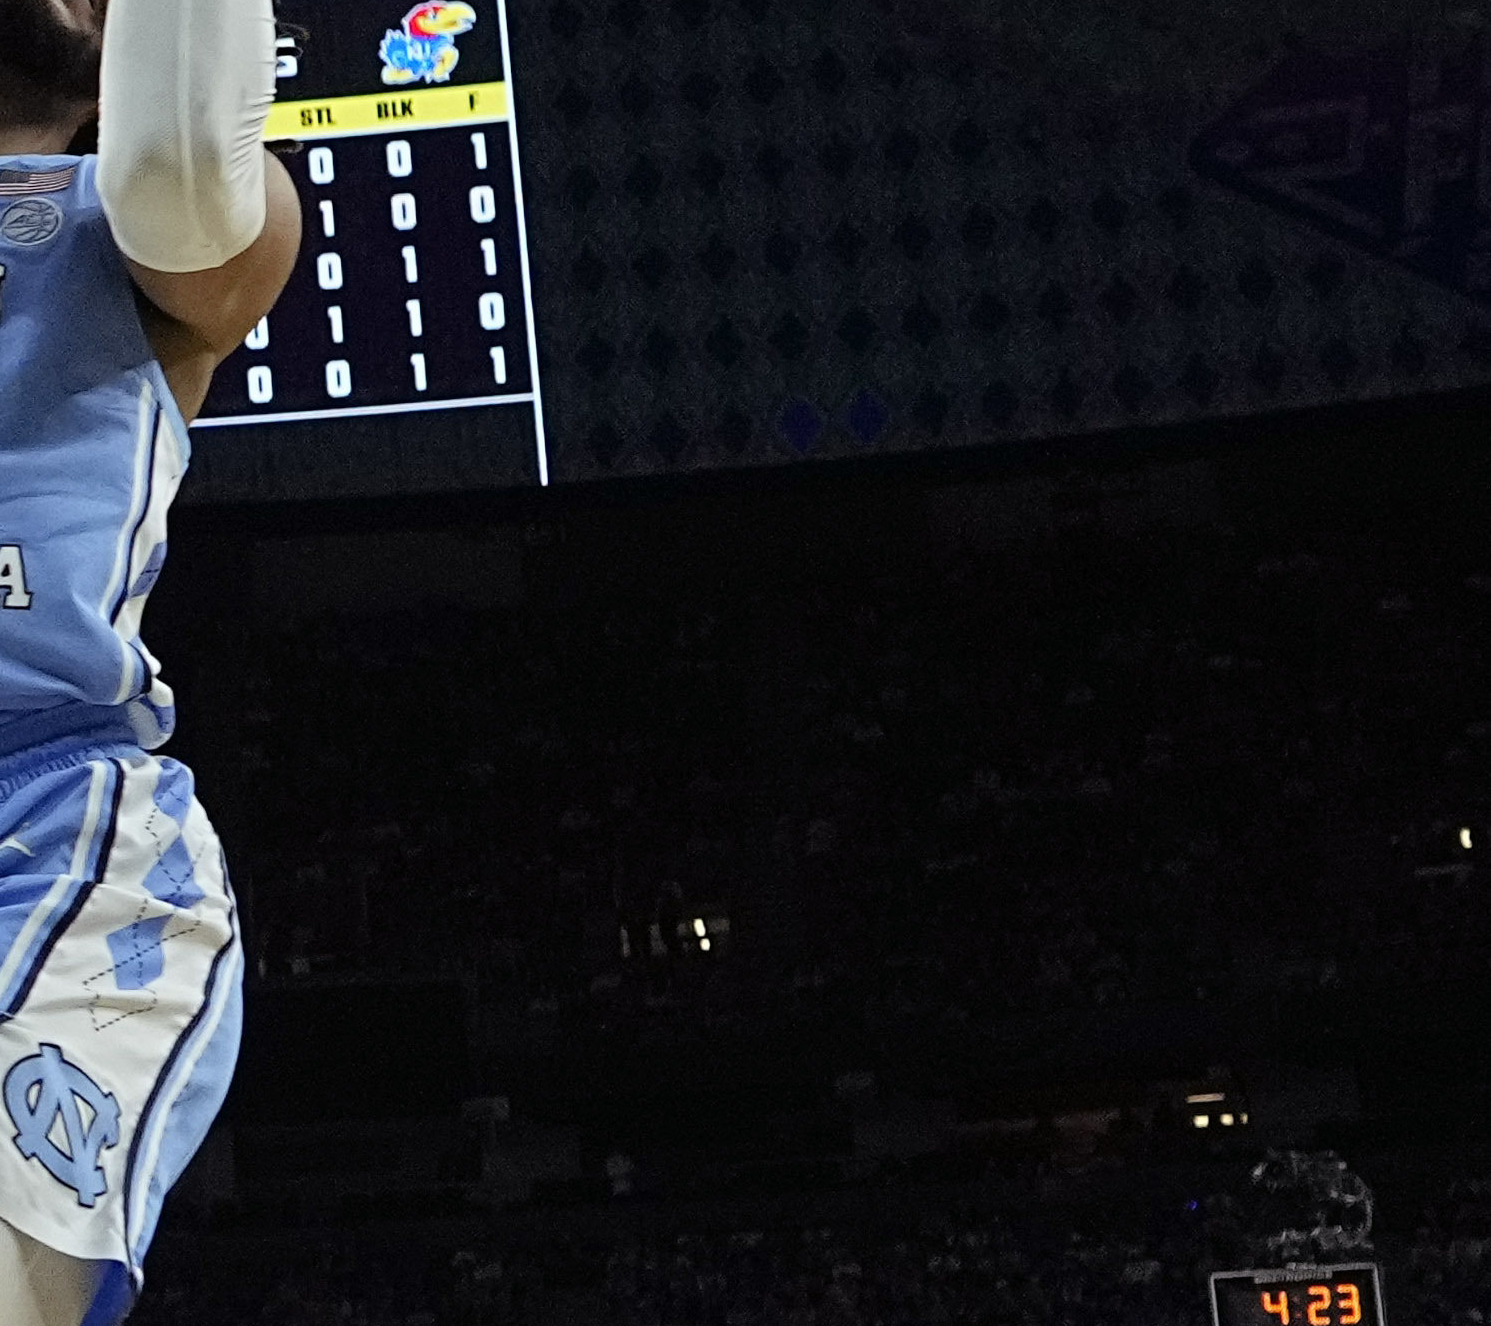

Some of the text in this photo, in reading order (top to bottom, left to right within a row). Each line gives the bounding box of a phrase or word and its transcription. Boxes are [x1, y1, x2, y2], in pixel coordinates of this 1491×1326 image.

[300, 106, 337, 126] STL
[377, 99, 414, 119] BLK
[308, 132, 487, 184] 0 0 1
[319, 185, 495, 237] 1 0 0
[317, 238, 497, 290] 0 1 1
[328, 305, 344, 343] 1
[406, 299, 422, 337] 1
[479, 292, 505, 330] 0
[247, 346, 507, 404] 0 0 1 1
[1261, 1283, 1361, 1326] 4:23
